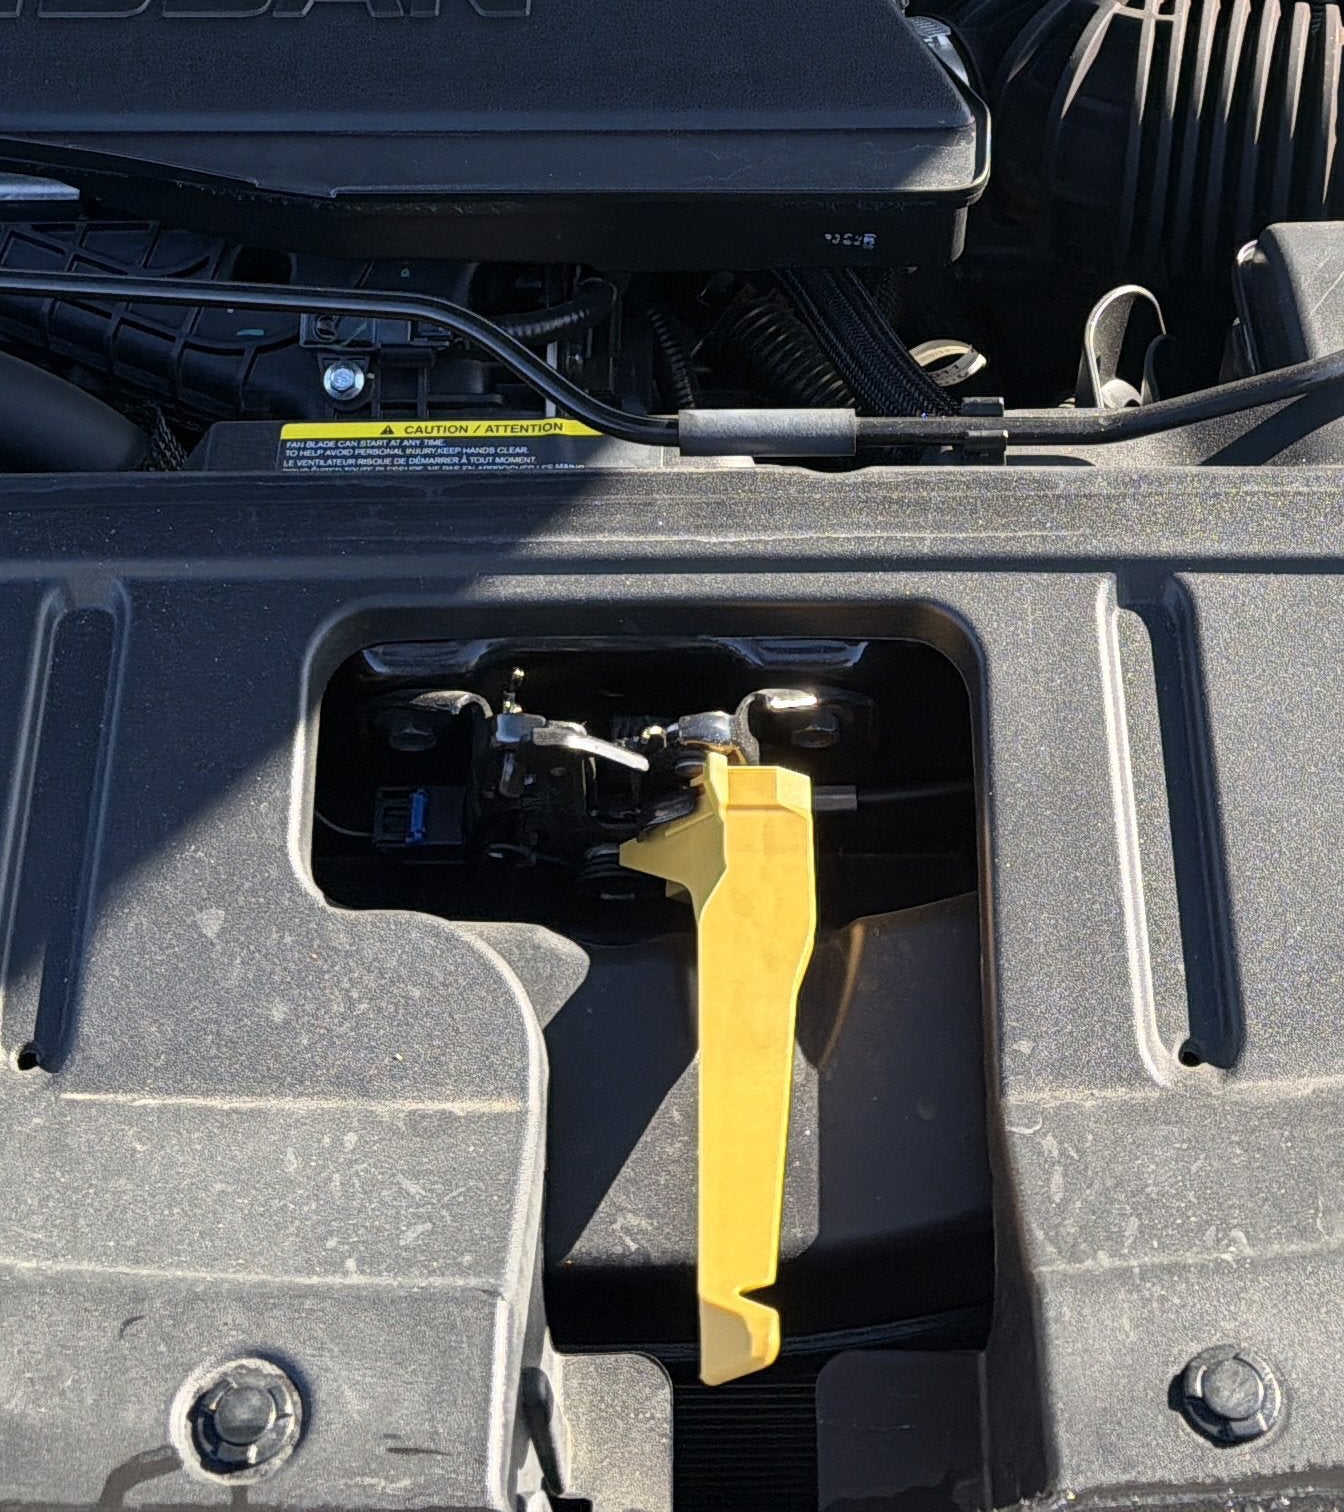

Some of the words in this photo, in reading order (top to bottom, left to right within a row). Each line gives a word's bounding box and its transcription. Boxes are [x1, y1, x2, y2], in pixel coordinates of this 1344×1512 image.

[404, 424, 469, 435] CAUTION
[484, 422, 564, 434] ATTENTION
[306, 440, 335, 448] BLADE
[337, 440, 357, 448] CAN
[359, 439, 389, 447] START
[389, 439, 401, 447] AT
[401, 439, 421, 447] ANY
[299, 449, 324, 457] HELP
[324, 448, 353, 456] AVOID
[355, 448, 403, 456] PERSONAL
[463, 446, 495, 454] HANDS
[283, 459, 295, 467] LE
[296, 458, 355, 466] VENTILATEUR
[357, 457, 392, 465] RISQUE
[394, 457, 407, 465] DE
[469, 456, 494, 464] TOUT
